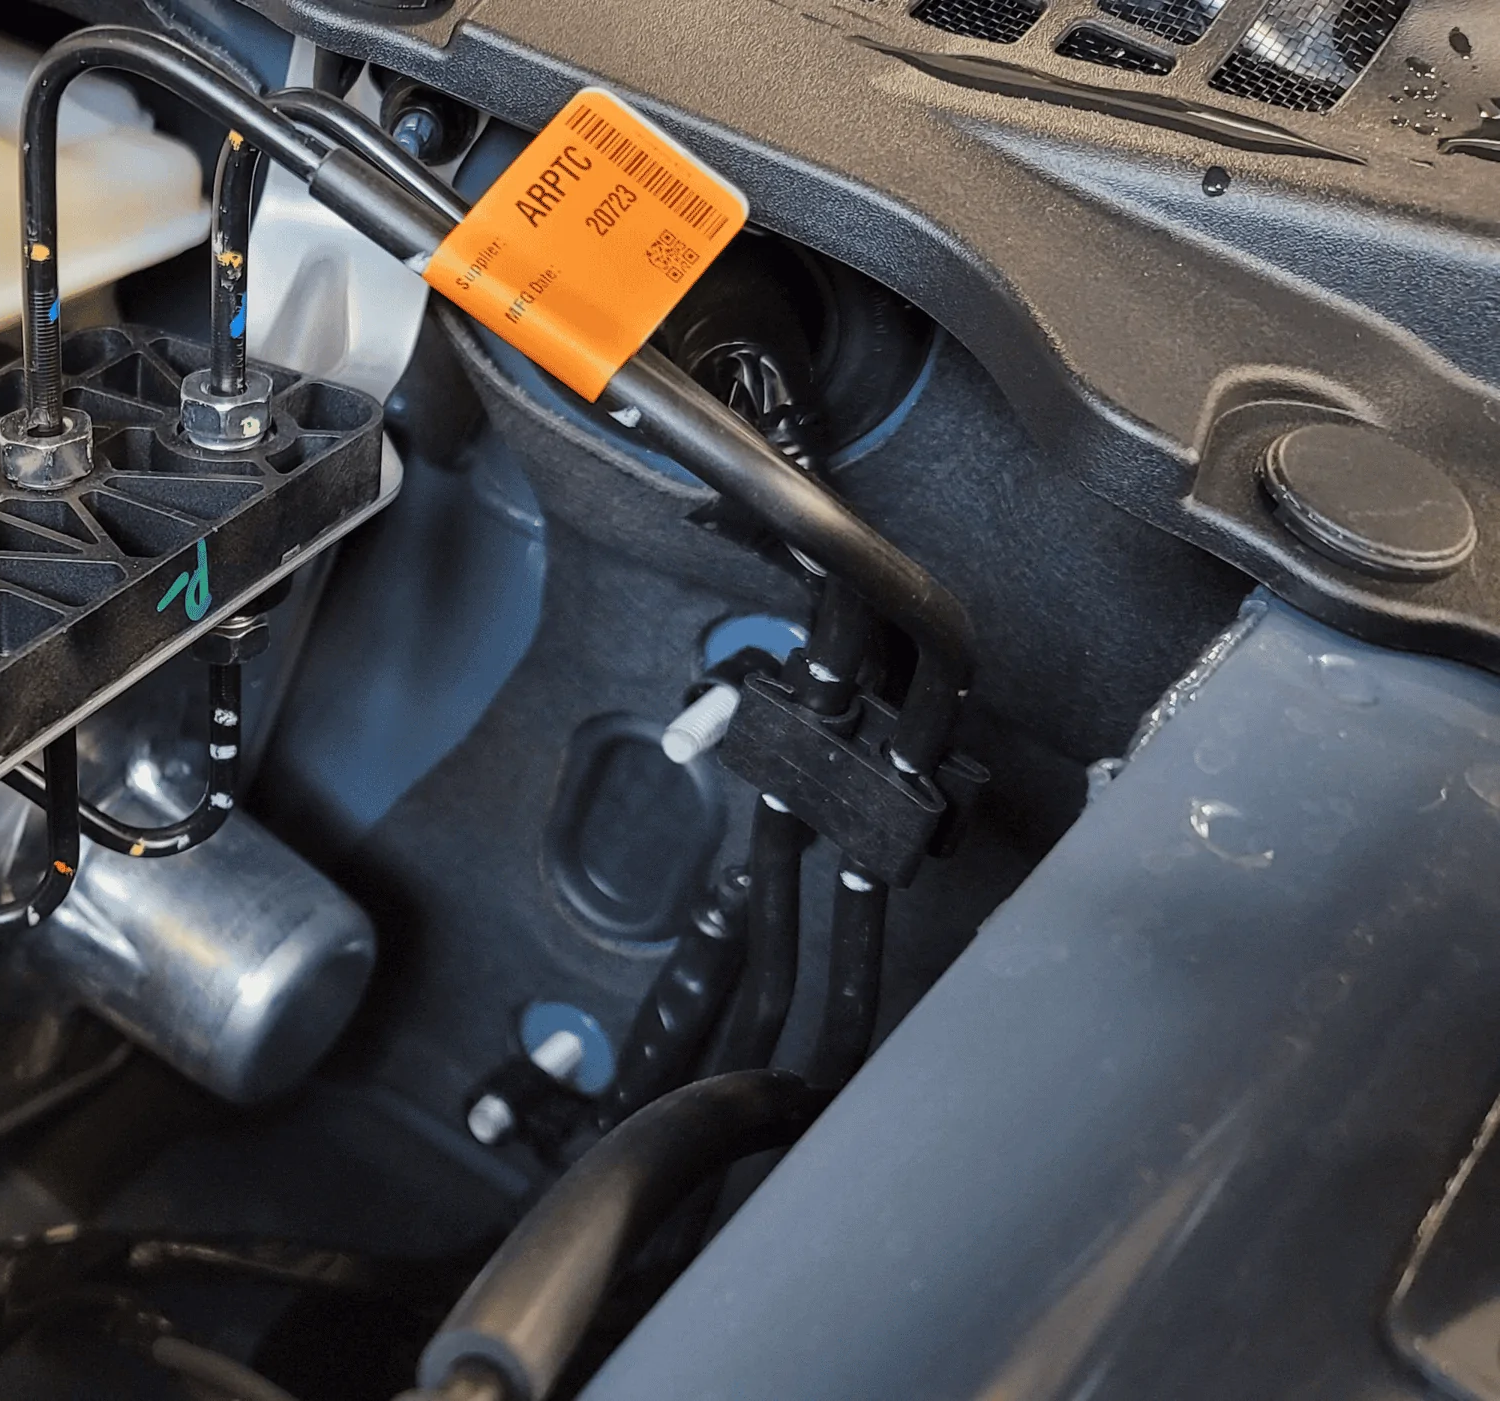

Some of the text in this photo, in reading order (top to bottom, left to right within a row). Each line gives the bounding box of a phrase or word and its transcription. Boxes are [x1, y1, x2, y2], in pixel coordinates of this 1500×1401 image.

[455, 145, 593, 290] Supplier: ARPTC
[585, 184, 638, 237] 20723
